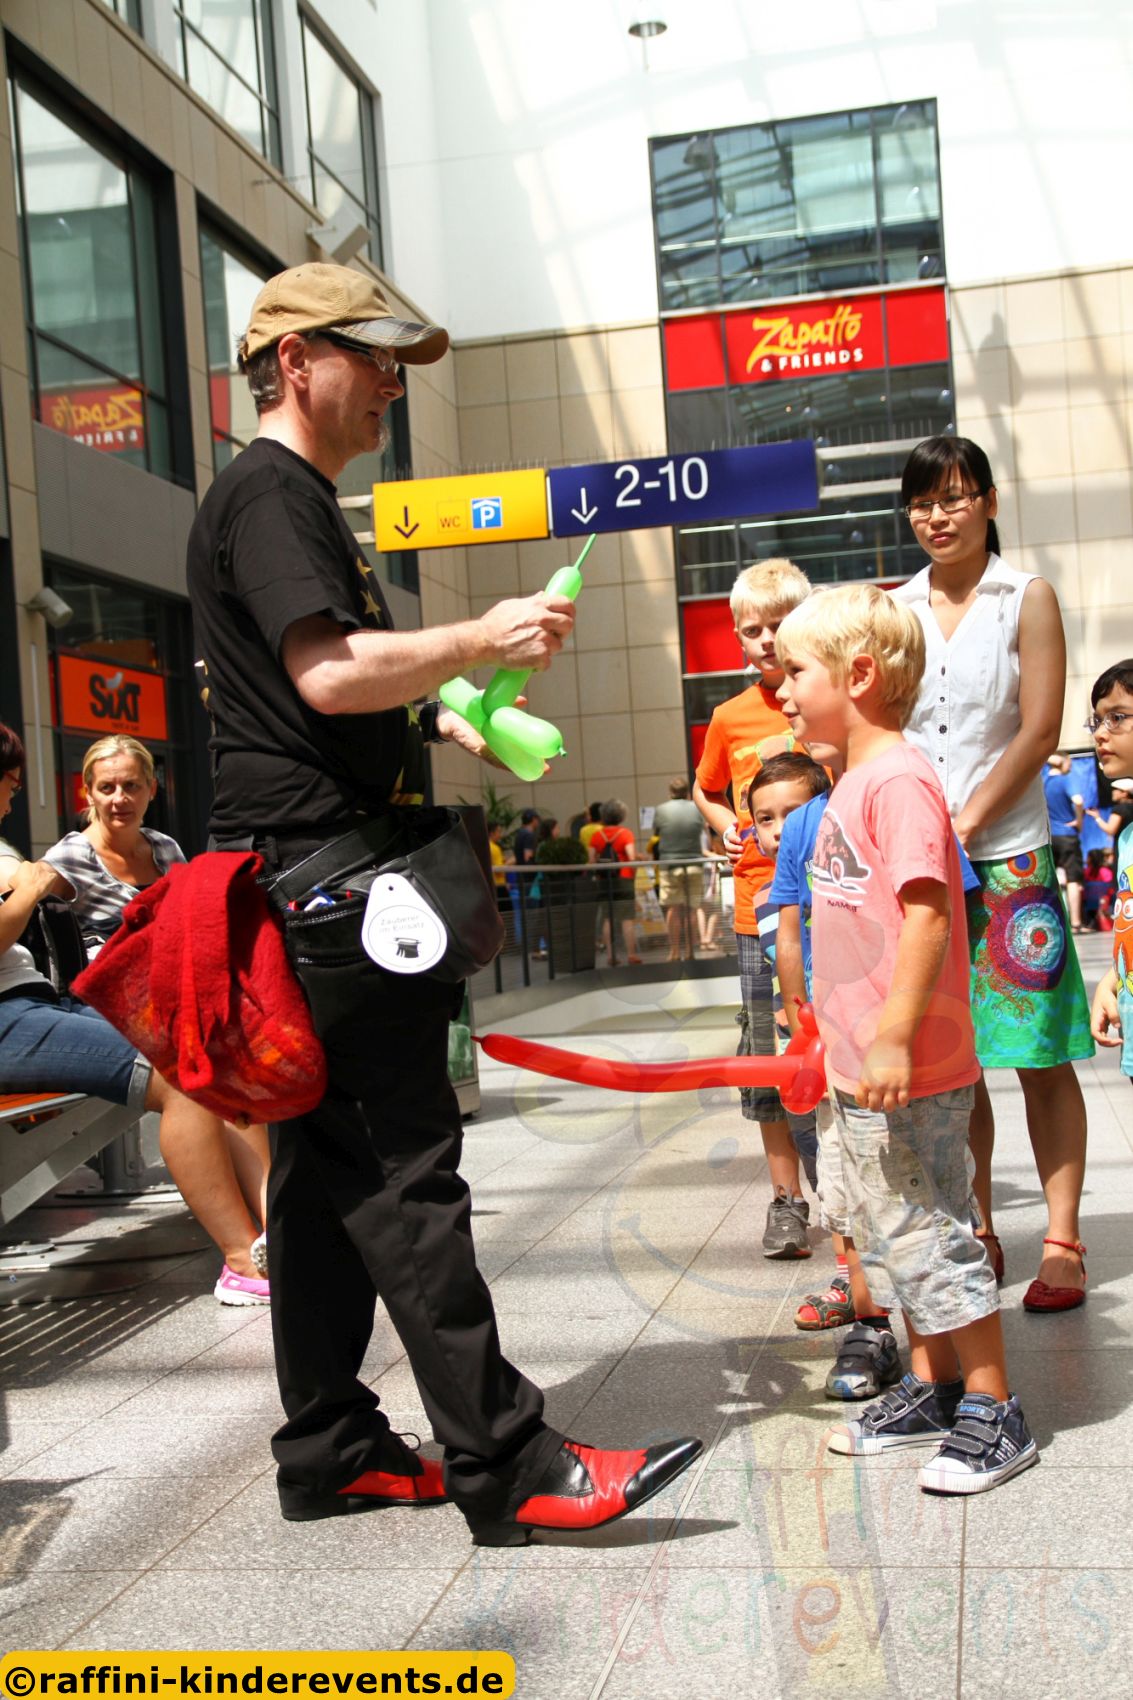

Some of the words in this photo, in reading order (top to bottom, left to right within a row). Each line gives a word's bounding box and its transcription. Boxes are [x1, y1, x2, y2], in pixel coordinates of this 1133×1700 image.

[745, 304, 863, 374] Zapatto
[760, 358, 773, 373] &
[778, 347, 864, 371] FRIENDS
[614, 456, 709, 508] 2-10
[439, 516, 461, 529] WC
[959, 1404, 986, 1415] SPORTS
